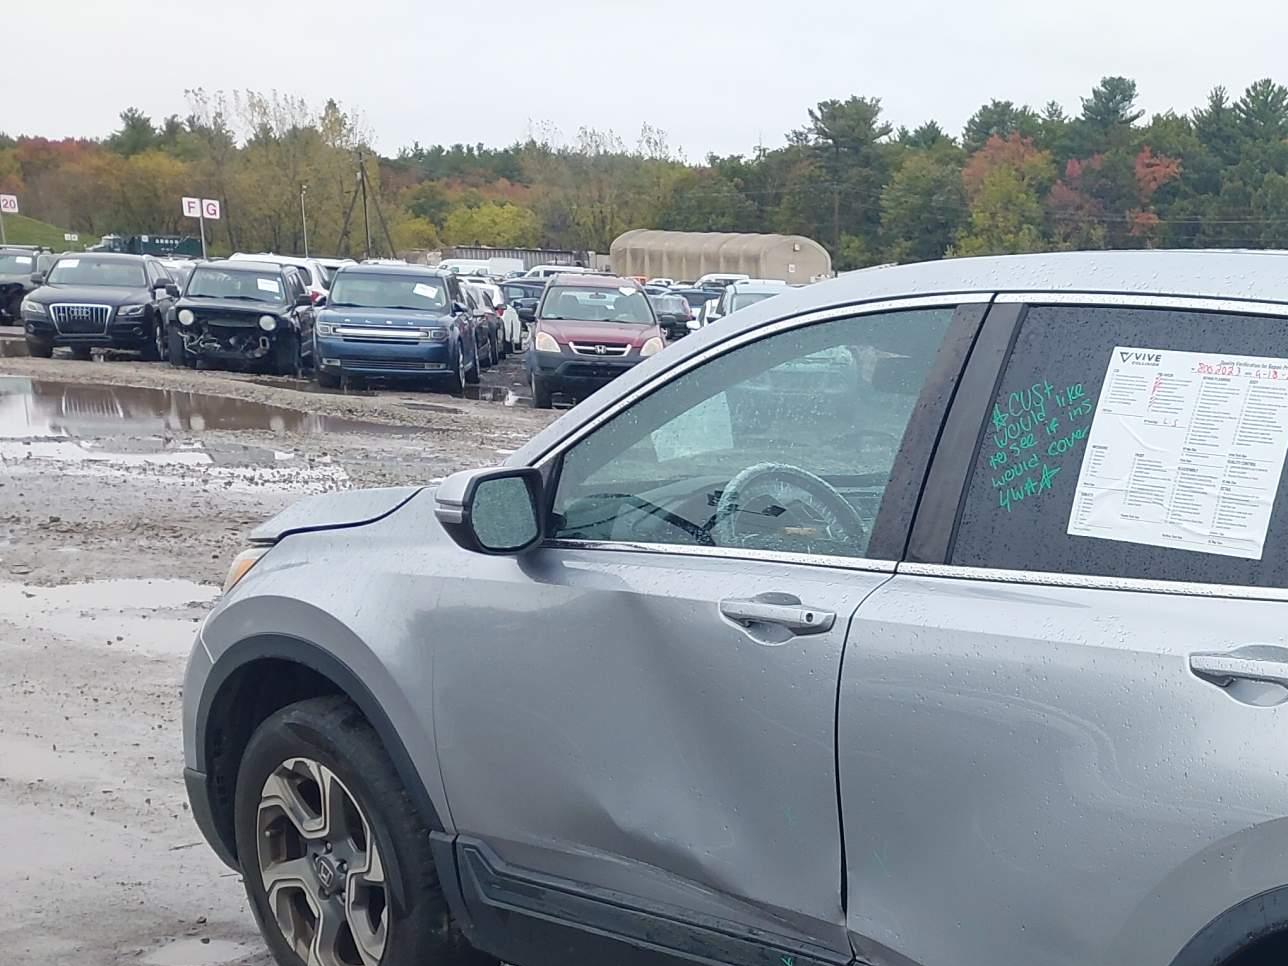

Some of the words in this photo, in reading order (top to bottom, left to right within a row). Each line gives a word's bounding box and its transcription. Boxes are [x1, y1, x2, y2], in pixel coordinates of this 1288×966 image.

[187, 201, 196, 214] F
[205, 202, 217, 216] G
[1135, 353, 1162, 363] VIVE
[1055, 383, 1085, 407] like
[1009, 433, 1036, 456] see
